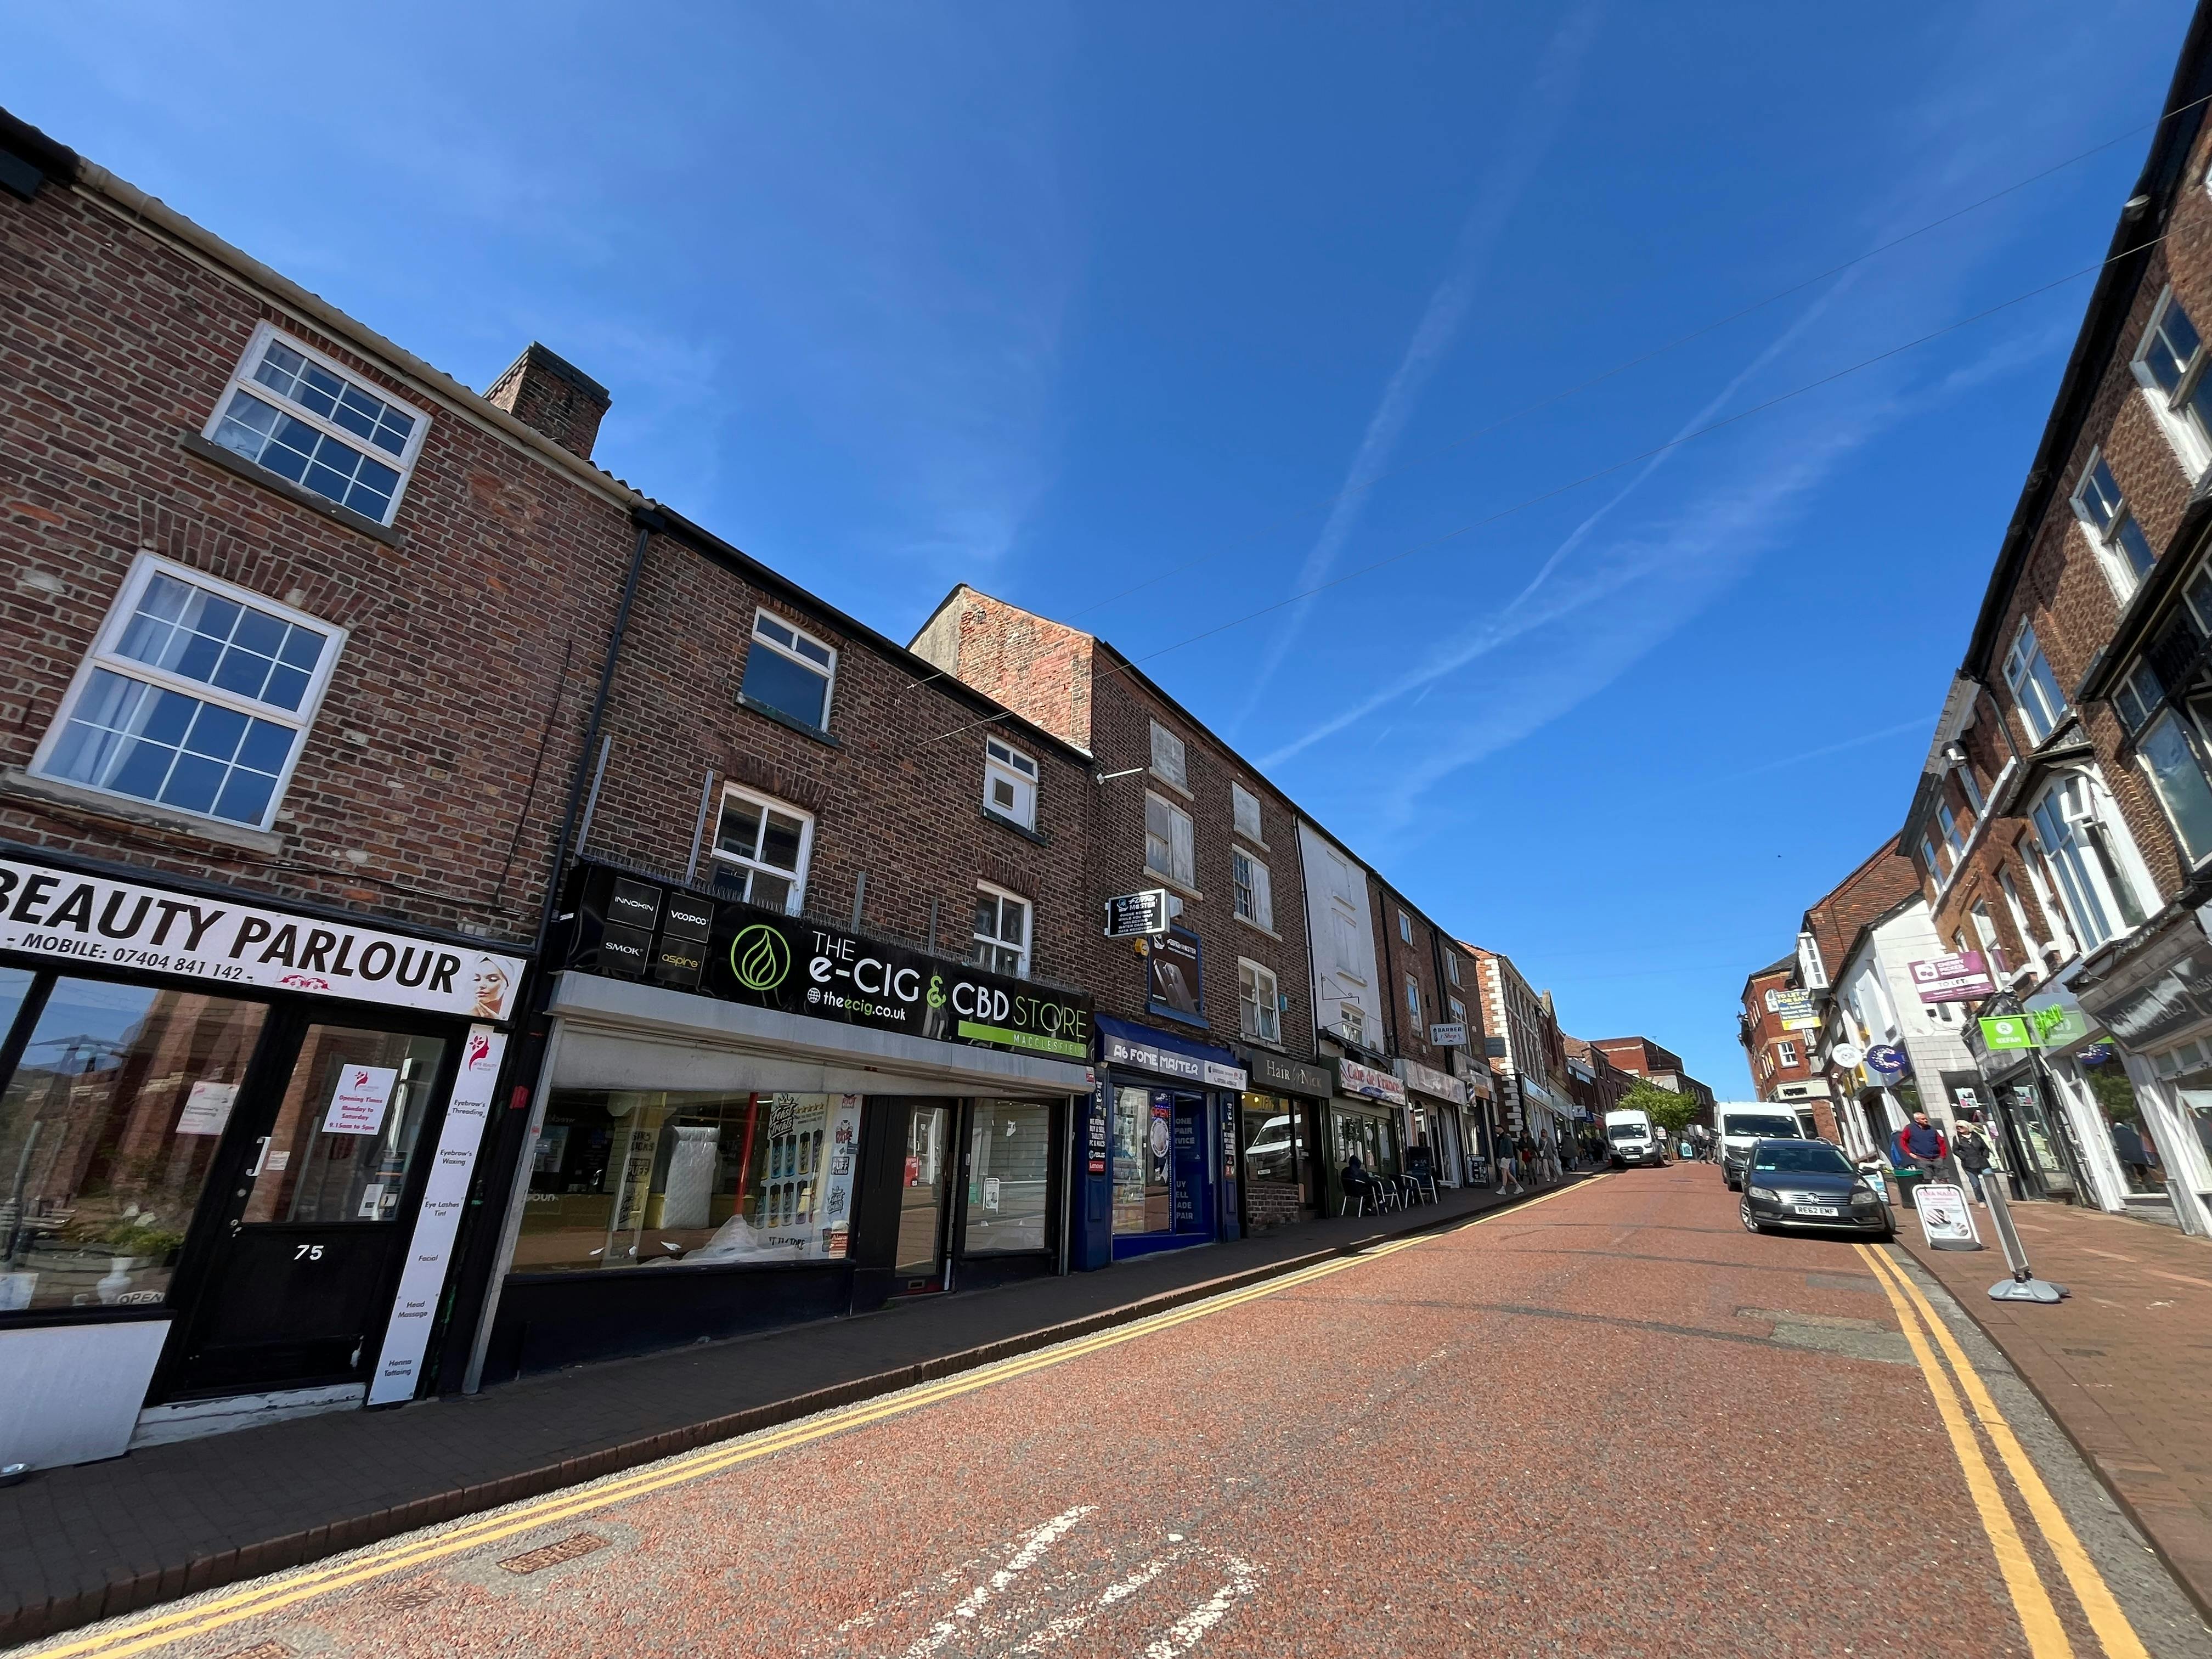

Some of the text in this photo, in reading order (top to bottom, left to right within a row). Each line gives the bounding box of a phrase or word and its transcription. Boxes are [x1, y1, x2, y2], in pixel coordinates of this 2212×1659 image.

[614, 896, 654, 911] INNOKIN
[671, 910, 707, 926] VOOPOO
[21, 933, 106, 959] MOBILE:
[113, 948, 170, 968] 07404
[173, 958, 206, 973] 841
[212, 964, 243, 980] 142
[228, 916, 461, 994] PARLOUR
[605, 942, 640, 956] SMOK
[812, 930, 856, 961] THE
[662, 953, 698, 968] aspire
[809, 956, 1087, 1039] e-CIG & CBD STORE
[823, 991, 906, 1021] theecig.co.uk
[1013, 1034, 1086, 1056] MACCLESFIELD
[1130, 1048, 1159, 1066] FONE
[1159, 1055, 1198, 1076] MASTER
[452, 1108, 483, 1116] Threading
[294, 1245, 324, 1261] 75
